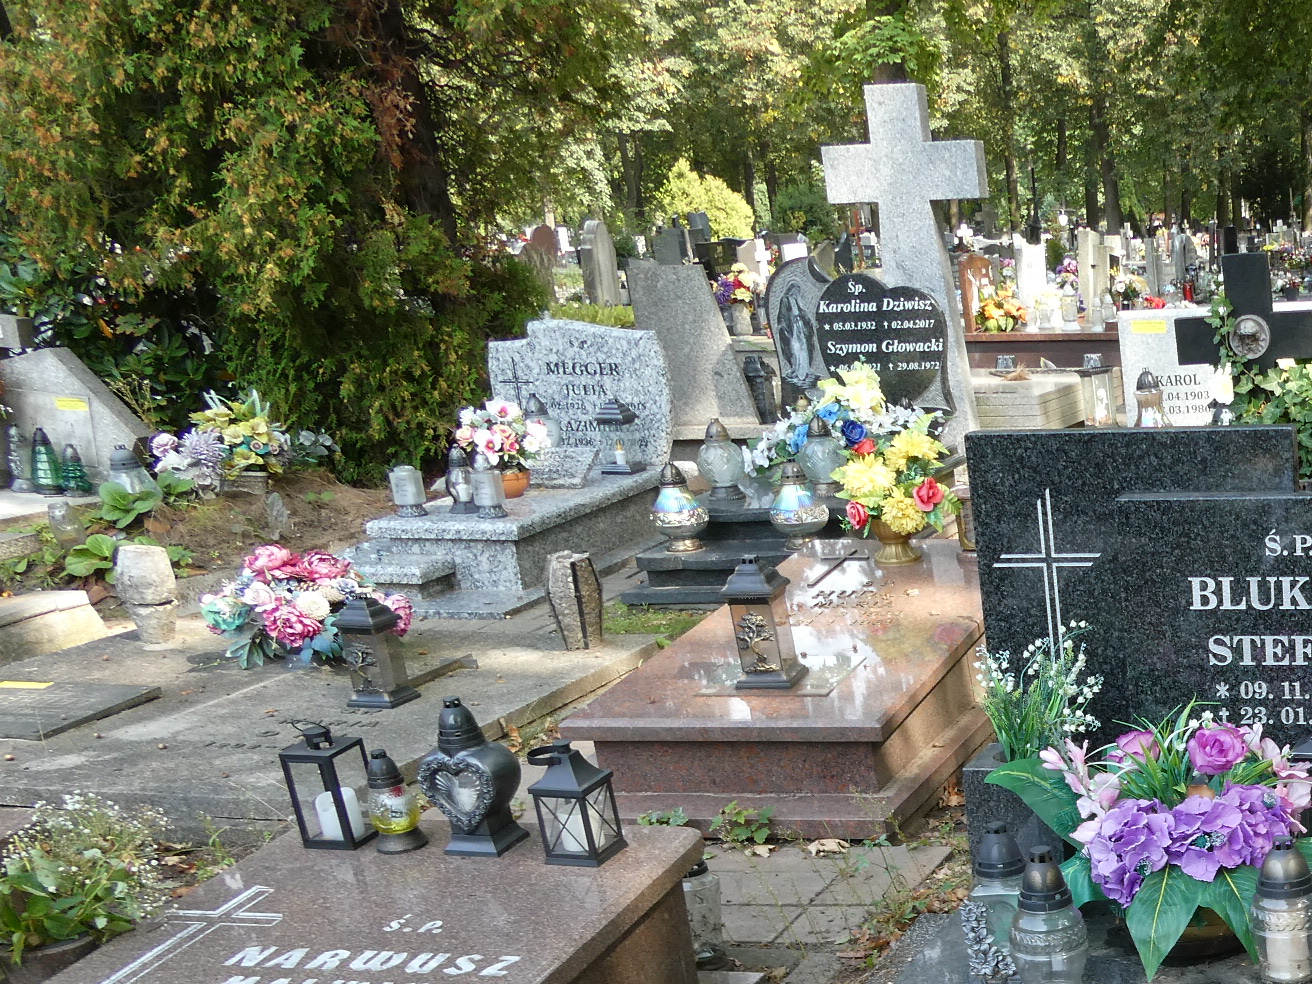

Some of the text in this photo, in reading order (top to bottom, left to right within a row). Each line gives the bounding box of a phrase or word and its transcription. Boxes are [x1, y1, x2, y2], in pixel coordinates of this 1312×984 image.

[819, 296, 932, 313] Karolina Dziwisz
[833, 320, 935, 330] 05.03.1932 02.04.2017
[827, 338, 943, 356] Szymon Głowacki
[545, 361, 621, 376] MEGGER
[897, 362, 940, 371] 29.08.1972
[1155, 374, 1201, 386] KAROL
[565, 384, 608, 396] JULIA
[221, 945, 521, 976] NARWUSZ
